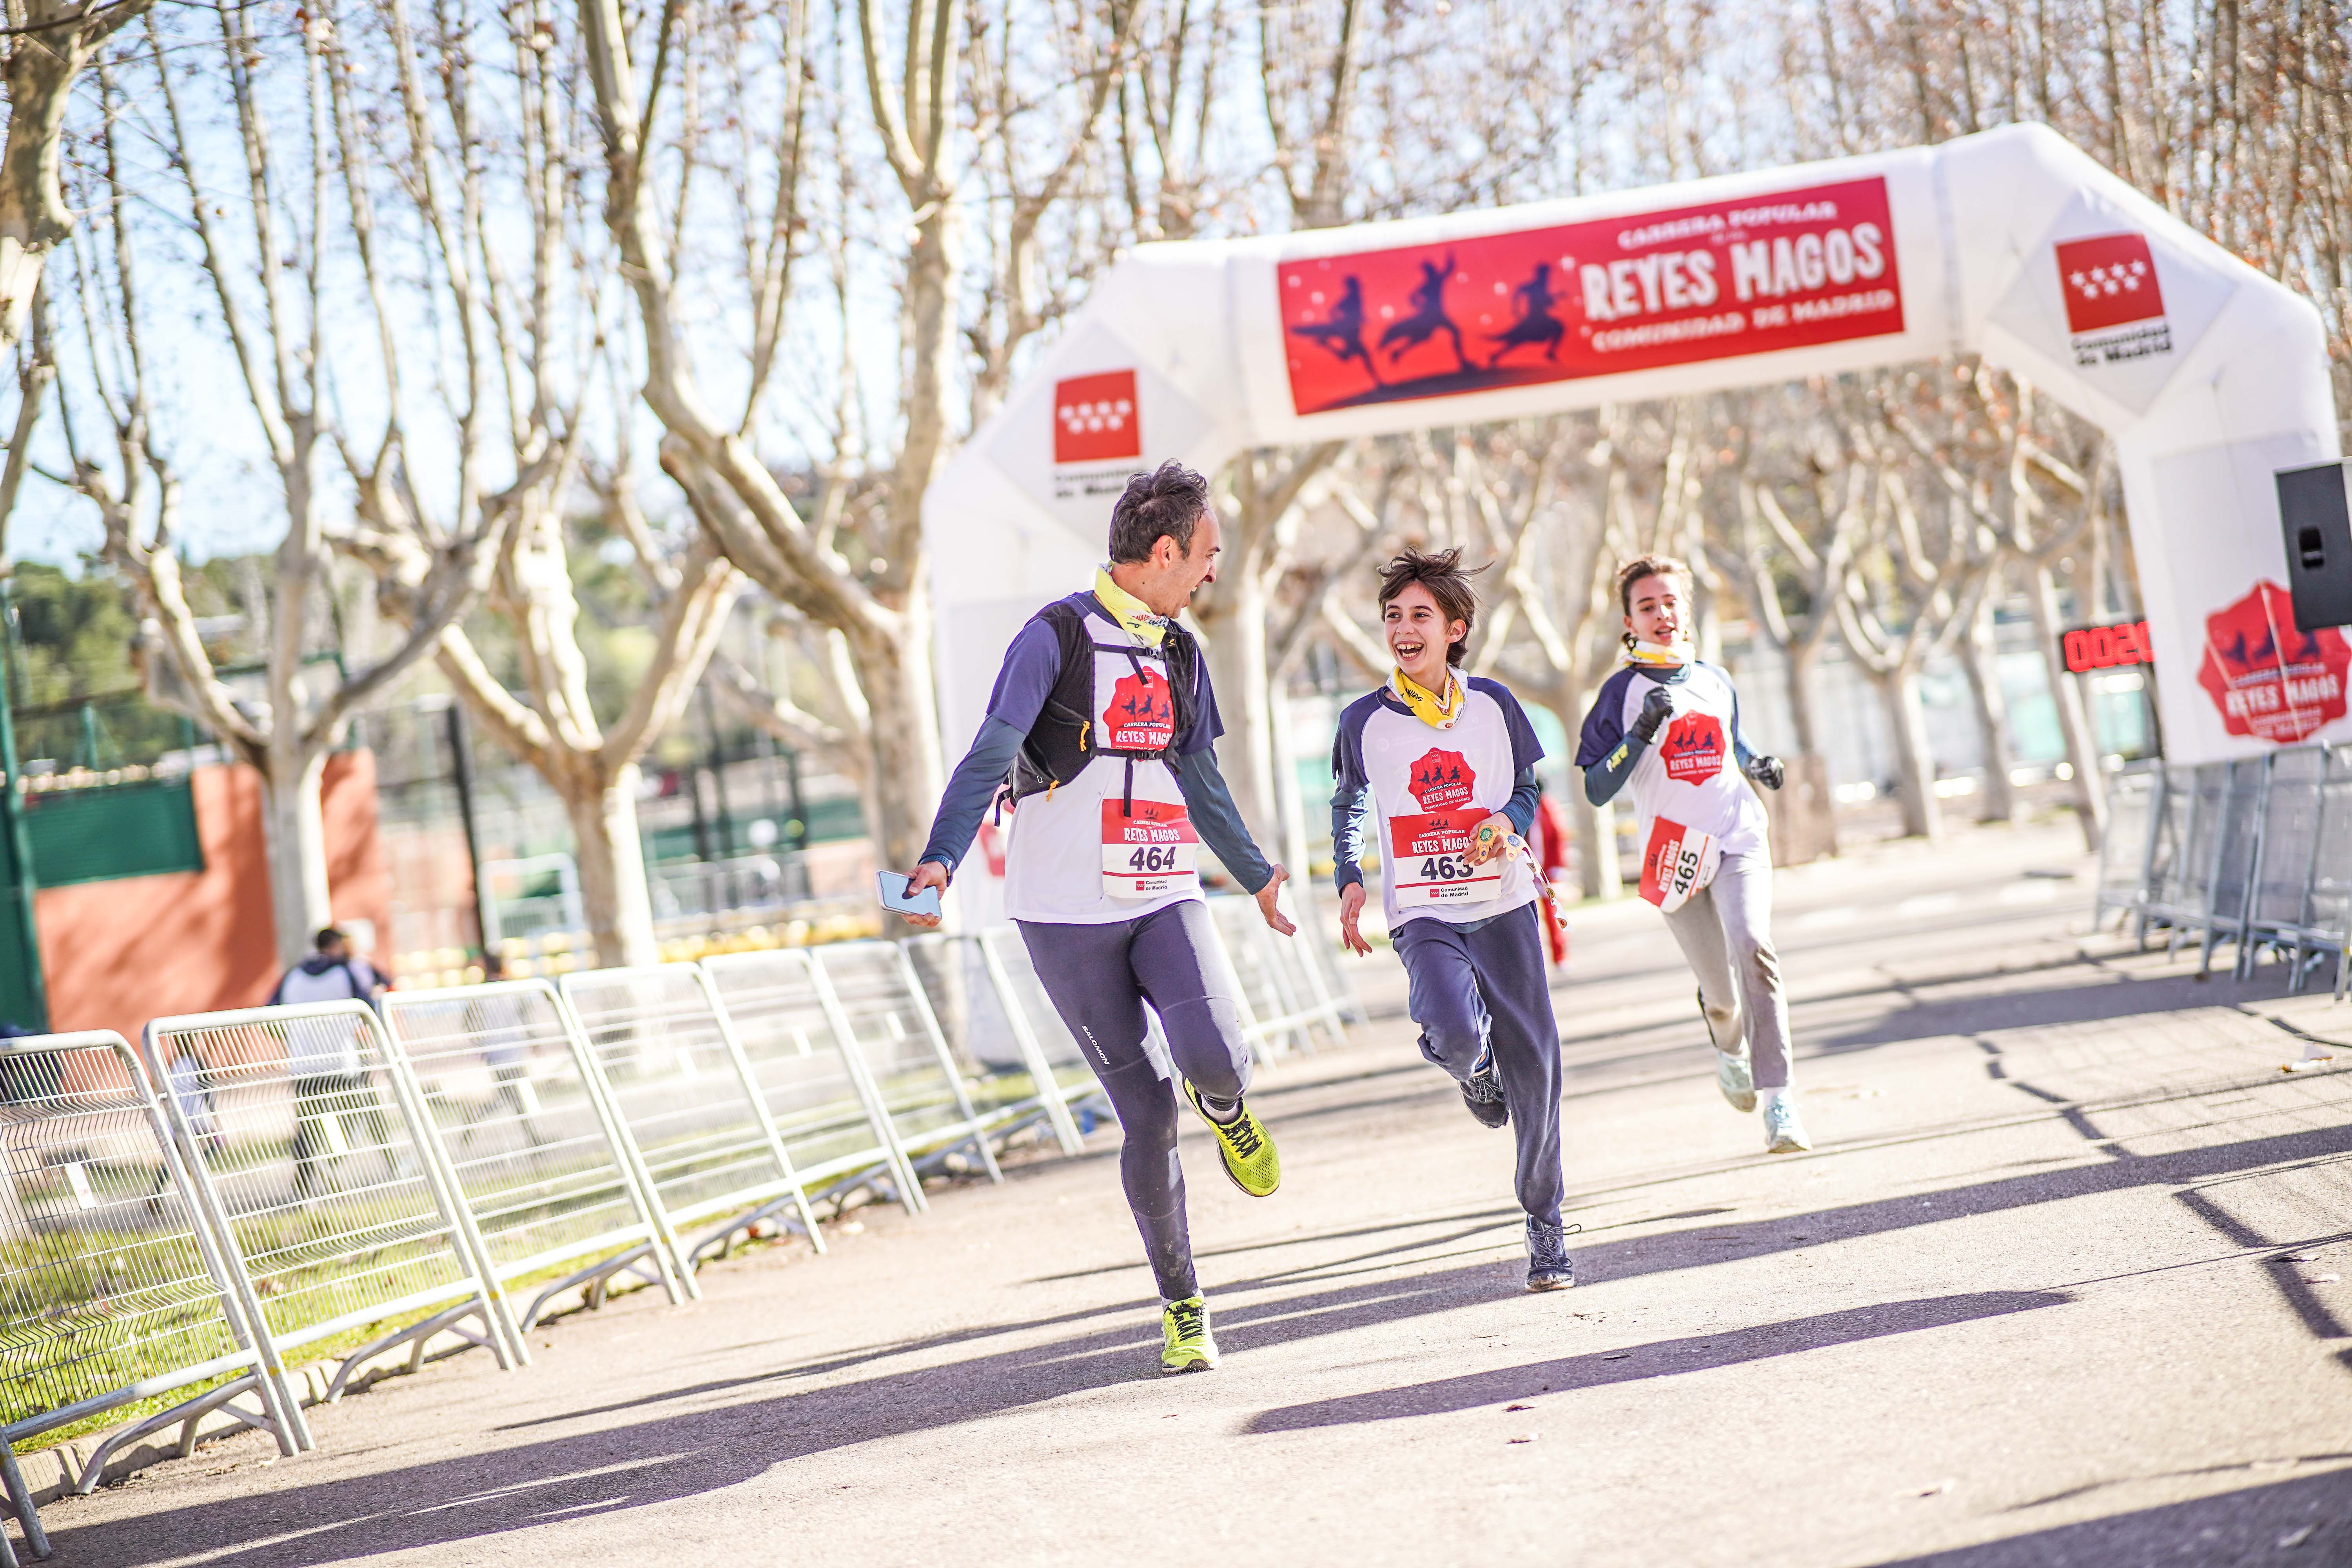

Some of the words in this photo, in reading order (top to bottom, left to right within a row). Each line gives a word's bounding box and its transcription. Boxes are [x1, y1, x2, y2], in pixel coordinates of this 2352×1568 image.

[1618, 214, 1726, 250] CARRERA
[1728, 201, 1838, 228] POPULAR
[1580, 249, 1719, 322] REYES
[1730, 222, 1885, 303] MAGOS
[1592, 312, 1746, 352] COMUNIDAD
[1752, 304, 1788, 329] DE
[1791, 289, 1896, 323] MADRID
[1116, 731, 1145, 743] REYES
[1423, 792, 1443, 804] REYES
[1445, 787, 1468, 799] MAGOS
[1124, 828, 1148, 842] REYES
[1150, 829, 1180, 842] MAGOS
[1412, 840, 1439, 853] REYES
[1129, 846, 1176, 871] 464
[1421, 855, 1473, 880] 463
[1675, 850, 1698, 894] 465
[1082, 1025, 1110, 1065] SALOMON
